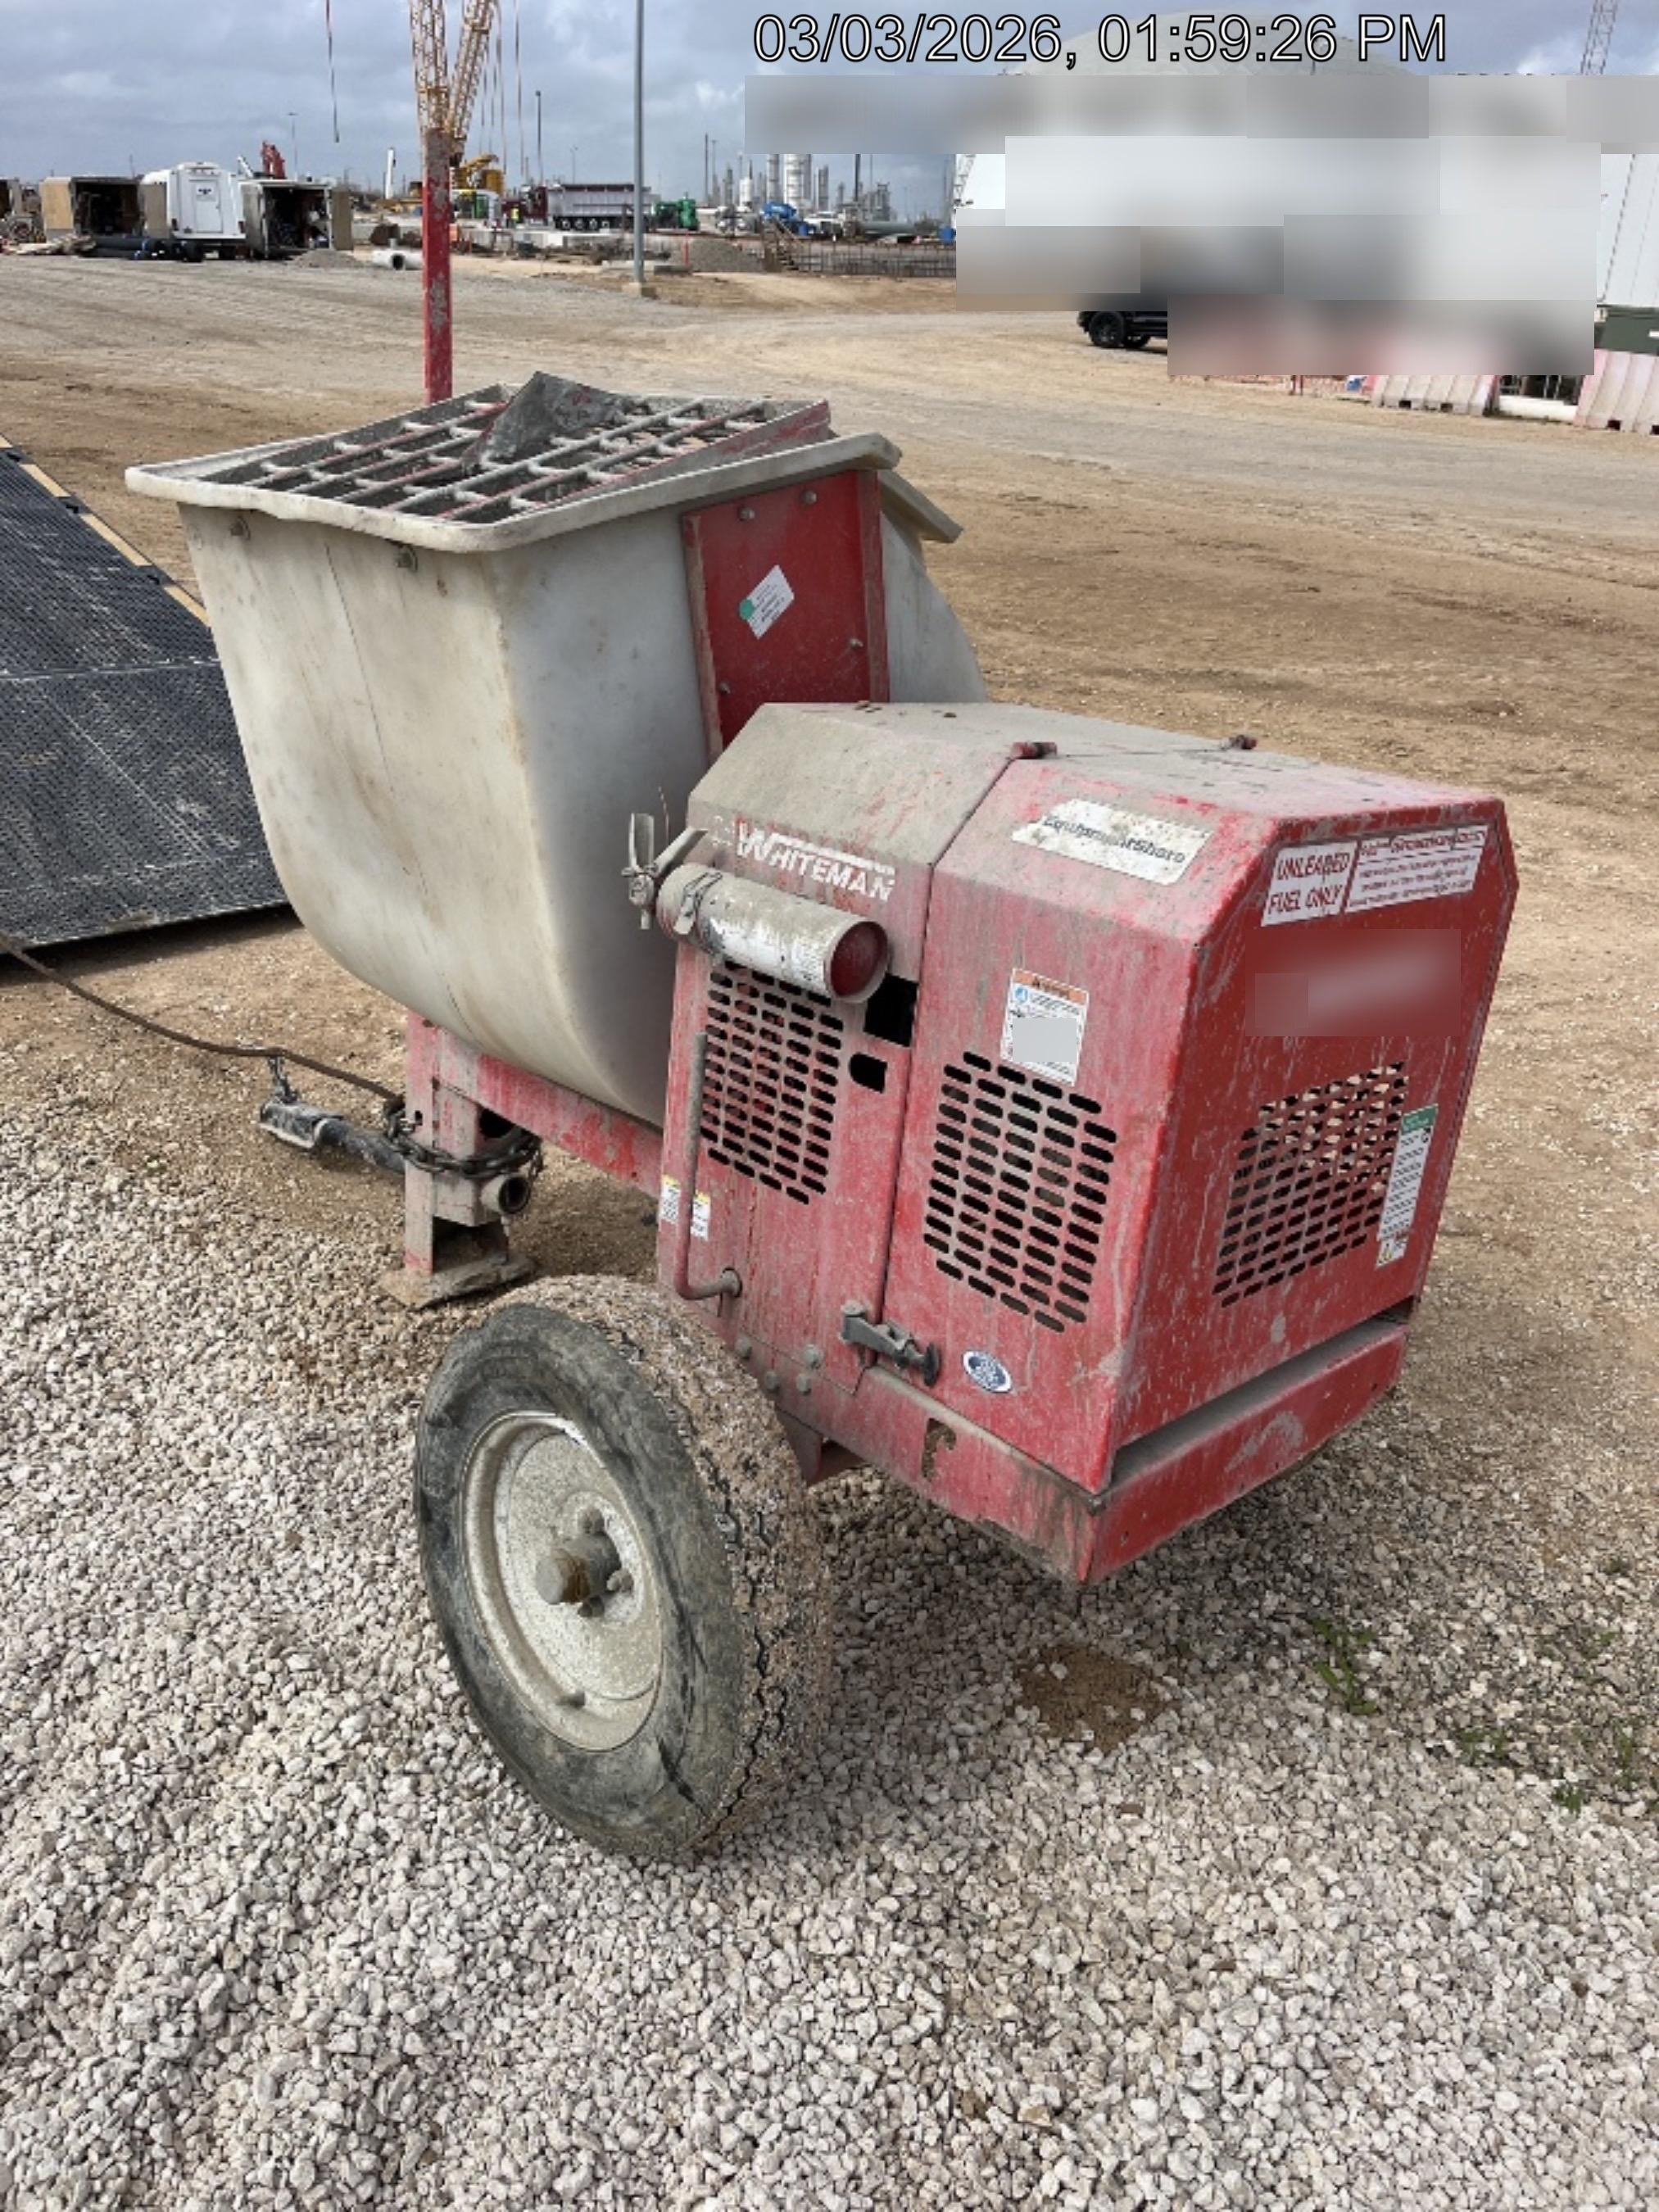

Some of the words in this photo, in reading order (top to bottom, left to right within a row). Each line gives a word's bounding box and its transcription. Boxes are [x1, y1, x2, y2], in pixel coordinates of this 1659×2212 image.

[736, 822, 895, 902] WHITEMAN
[1276, 851, 1351, 881] UNLEADED
[1267, 889, 1302, 915] FUEL
[1304, 884, 1343, 908] ONLY
